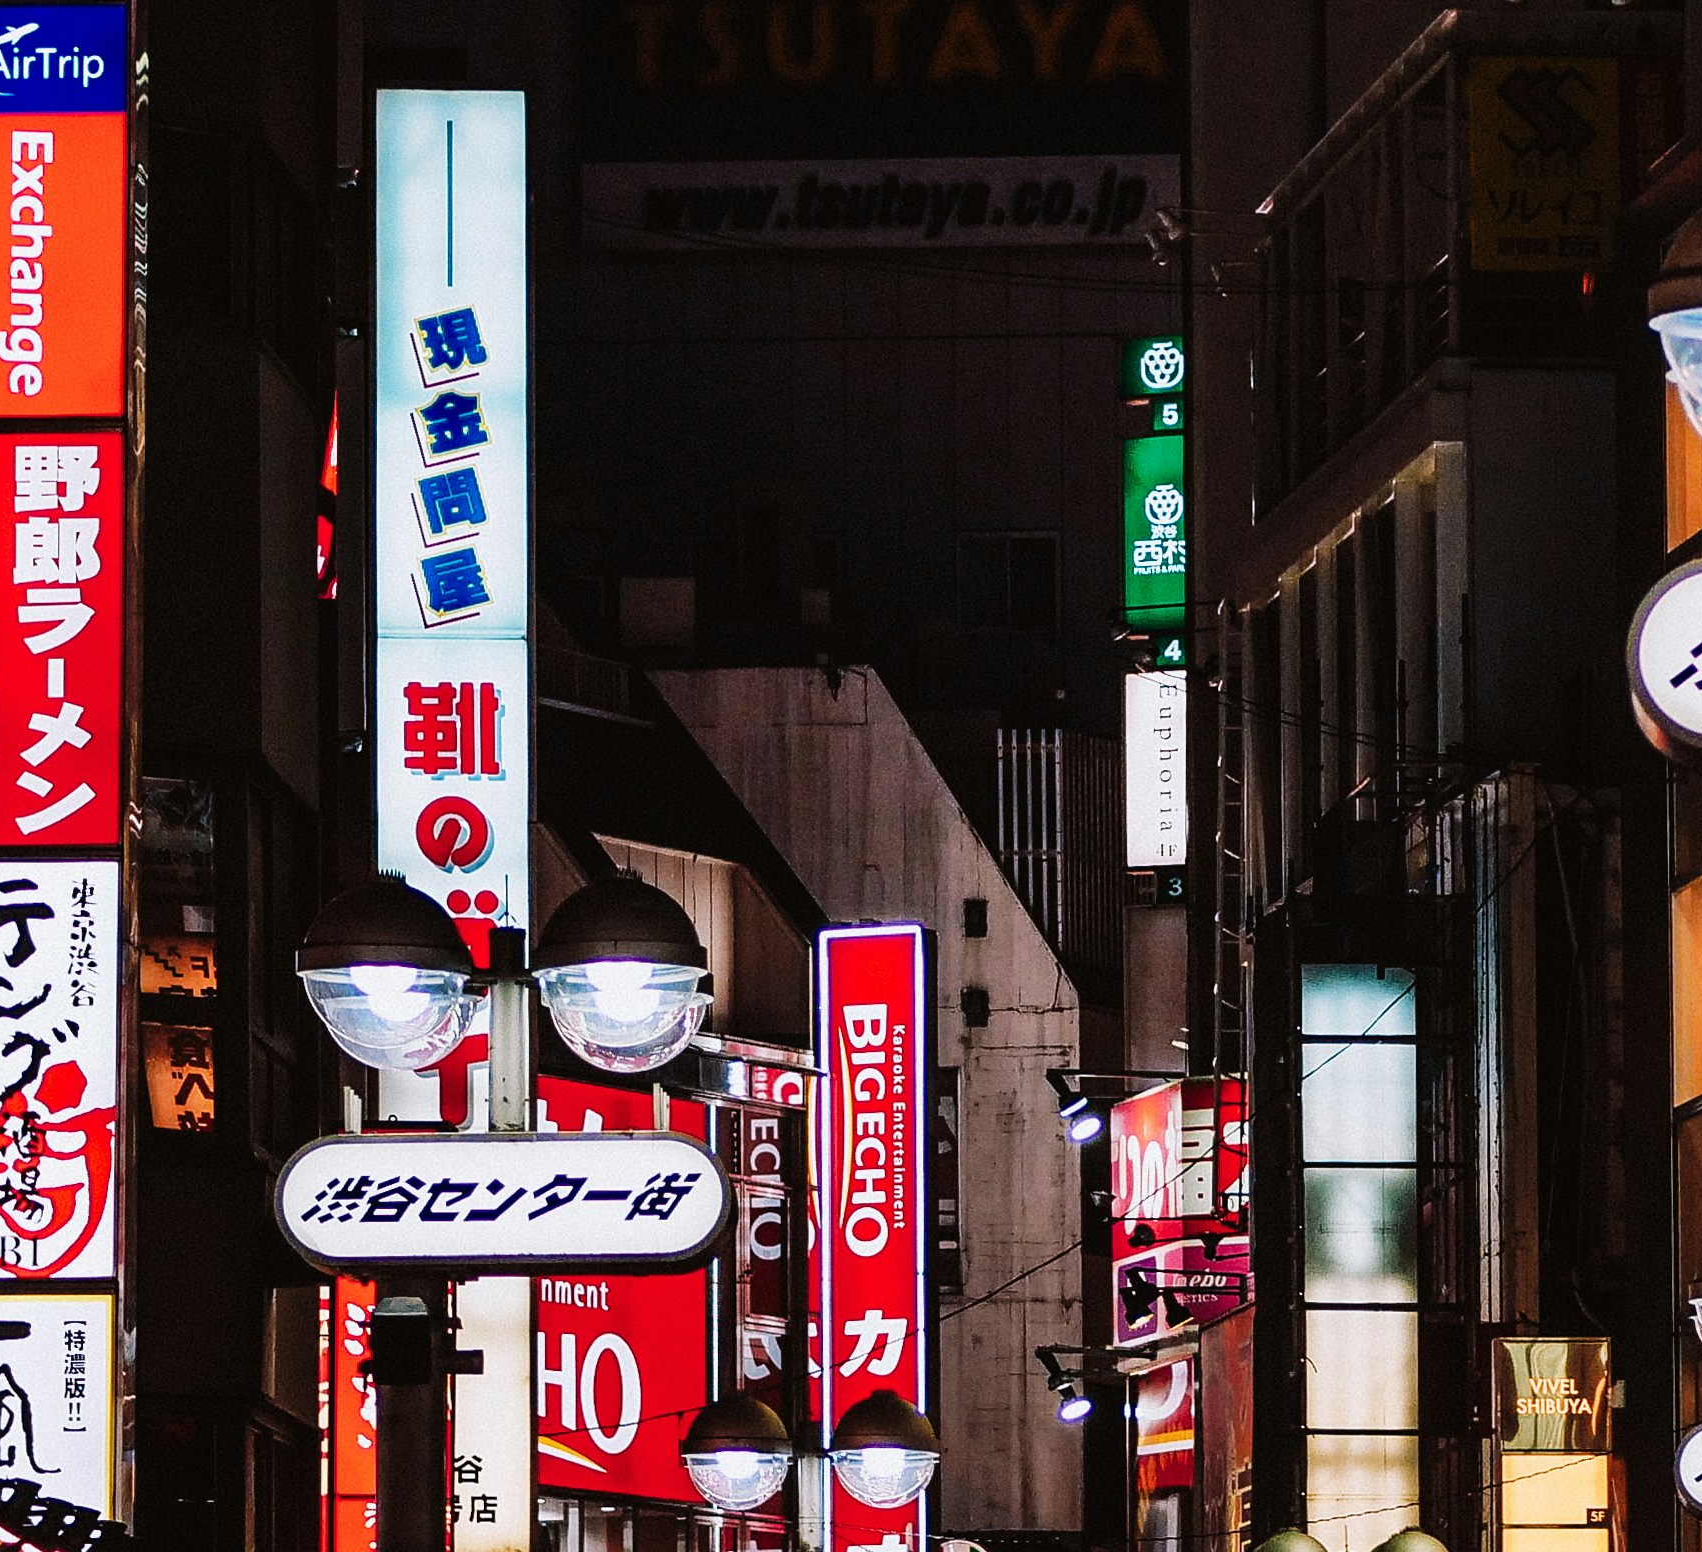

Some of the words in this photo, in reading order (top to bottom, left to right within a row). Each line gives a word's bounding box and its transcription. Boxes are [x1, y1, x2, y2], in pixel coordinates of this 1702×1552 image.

[623, 0, 1169, 87] TSUTAYA
[1162, 404, 1178, 425] 5
[415, 306, 492, 618] 現金問屋
[13, 445, 102, 836] 野郎ラーメン
[1165, 640, 1181, 661] 4
[1158, 683, 1177, 832] Euphoria
[1168, 877, 1183, 897] 3
[67, 878, 100, 1008] 東京渋谷
[843, 1003, 888, 1101] BIG
[892, 1023, 906, 1097] Karaoke
[300, 1171, 702, 1224] 渋谷センター街
[844, 1111, 889, 1257] ECHO
[892, 1101, 906, 1230] Entertainment
[541, 1278, 609, 1311] nment
[1516, 1398, 1593, 1416] SHIBUYA
[1529, 1378, 1579, 1395] VIVEL
[1589, 1510, 1607, 1524] 5F
